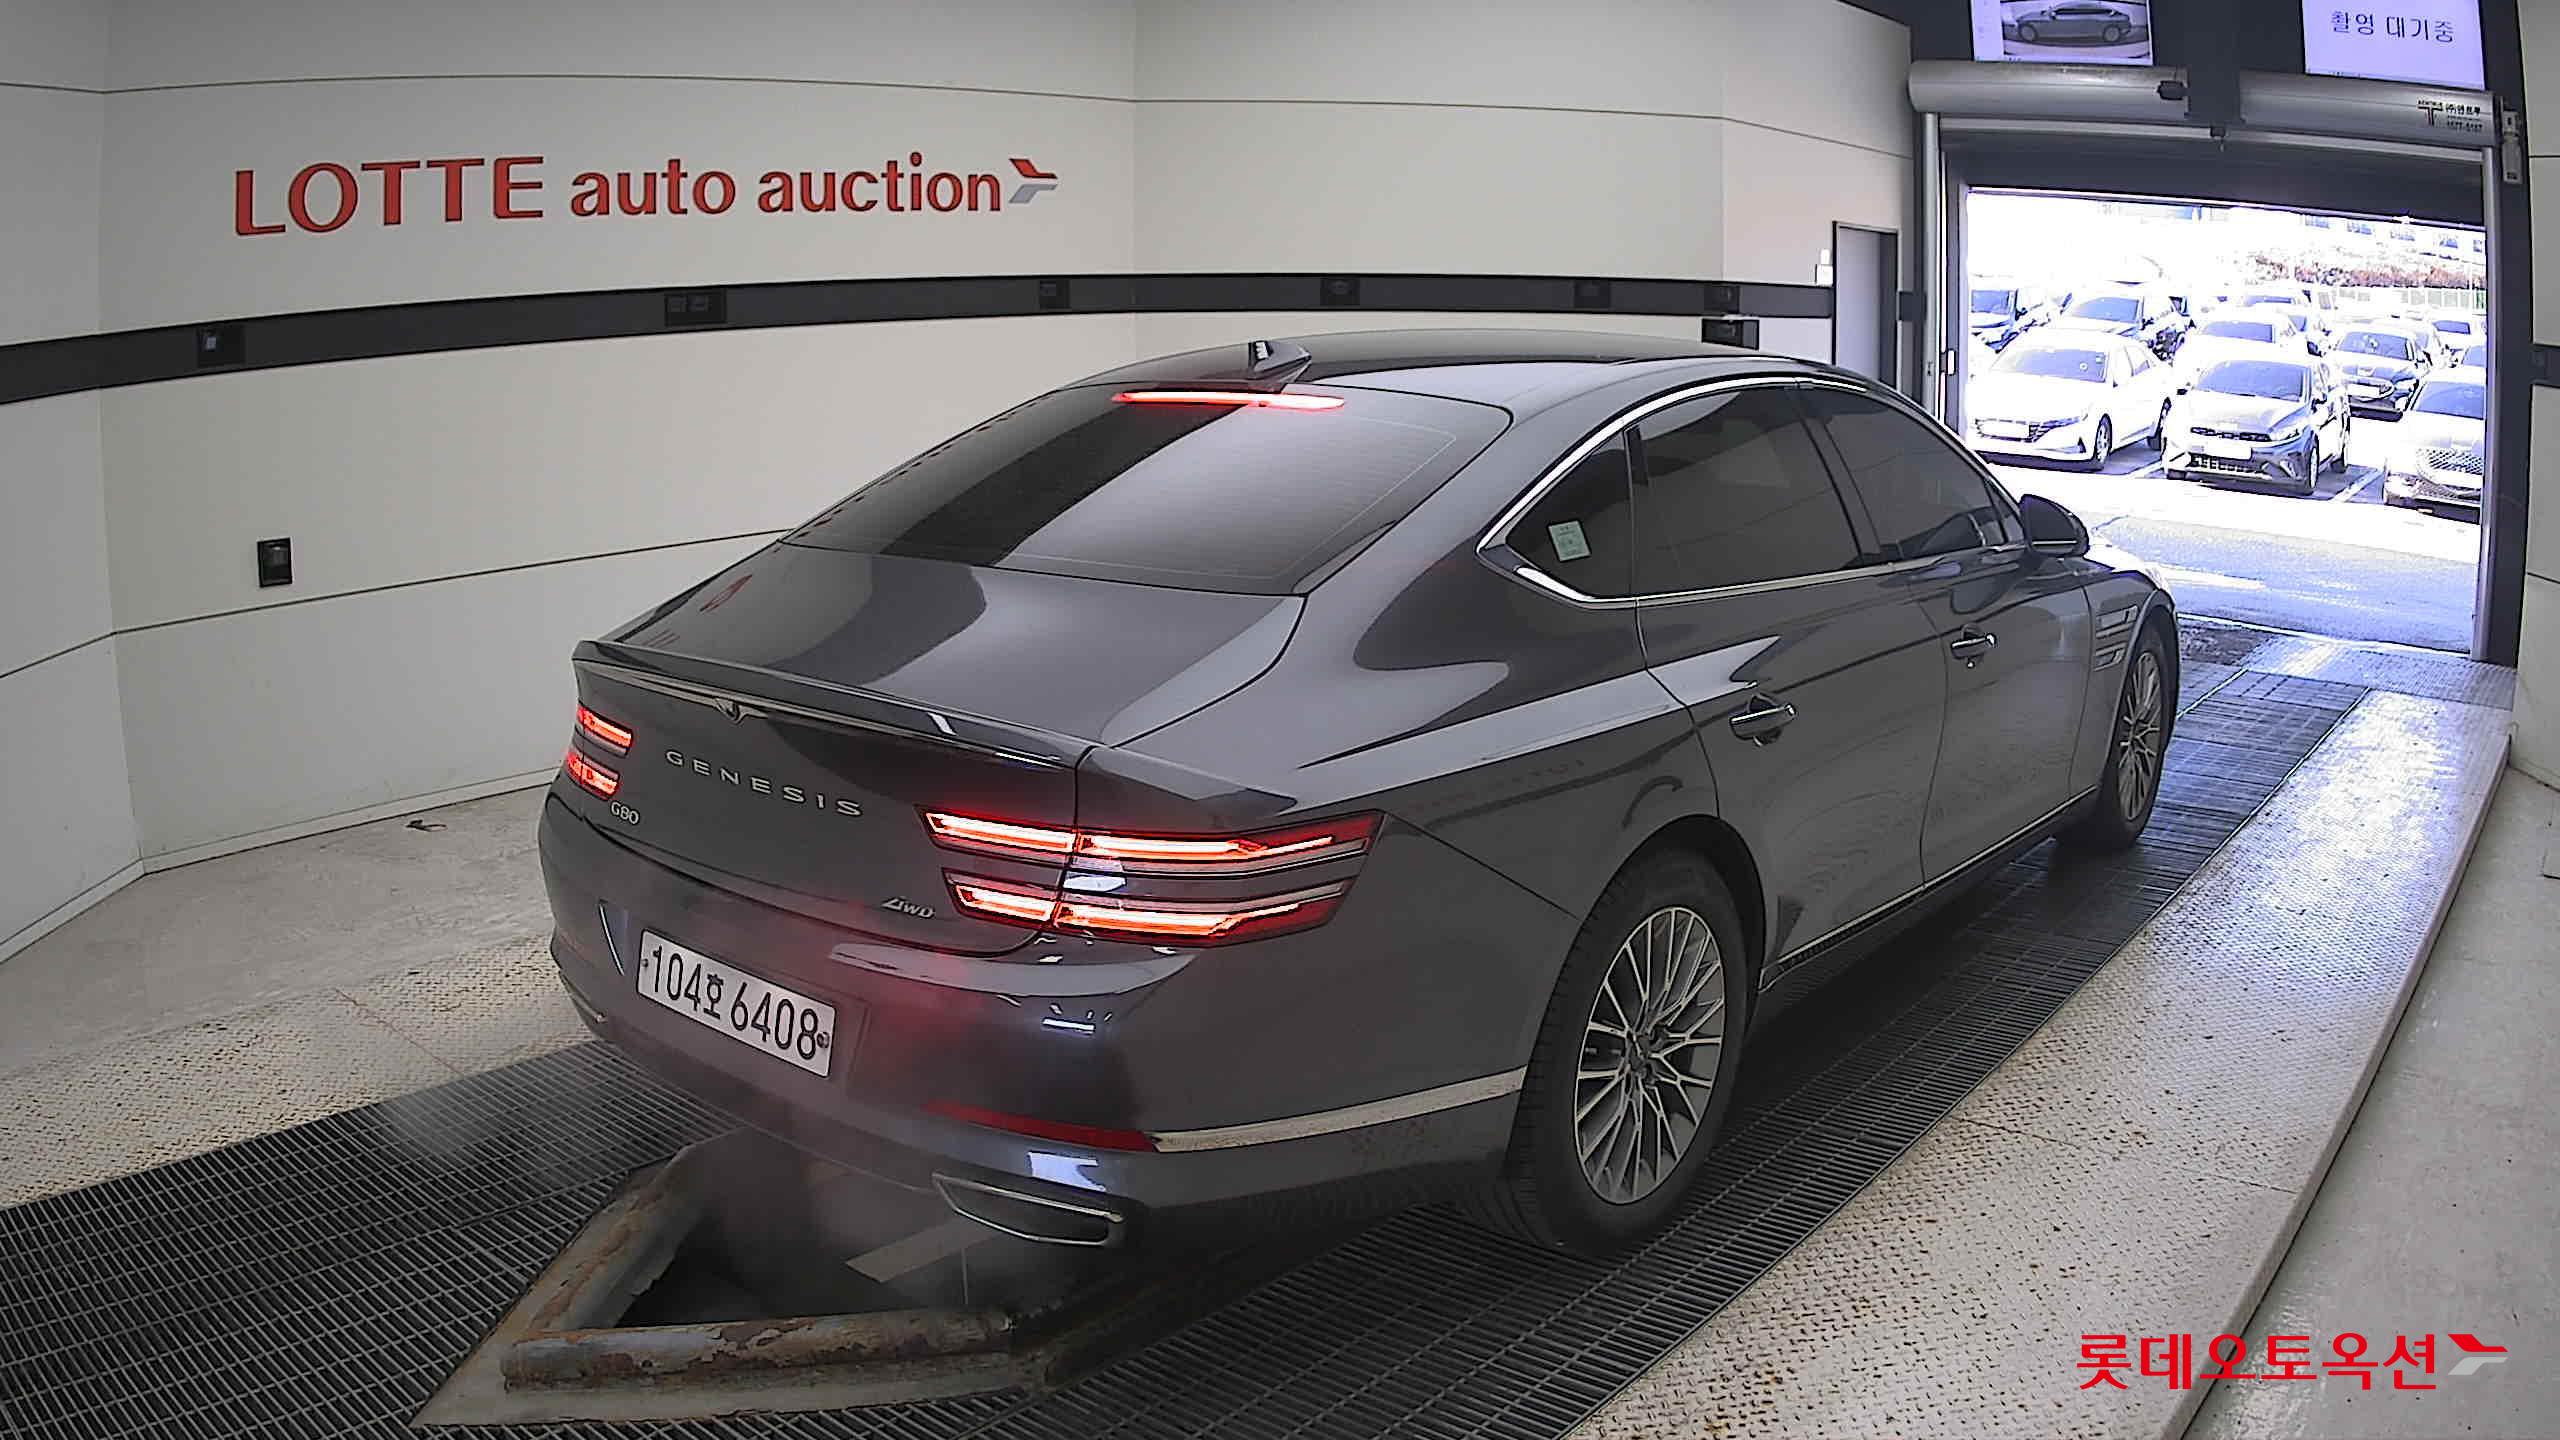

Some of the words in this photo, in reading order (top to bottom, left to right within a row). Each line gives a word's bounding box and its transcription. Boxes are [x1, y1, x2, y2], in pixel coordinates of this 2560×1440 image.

[2331, 11, 2375, 36] 촬영
[2386, 16, 2455, 43] 대기중
[234, 155, 542, 237] LOTTE
[571, 159, 737, 216] auto
[757, 152, 1002, 213] auction
[610, 800, 641, 826] G80
[665, 750, 864, 817] GENESIS
[652, 945, 724, 1020] 104호
[731, 981, 818, 1060] 6408
